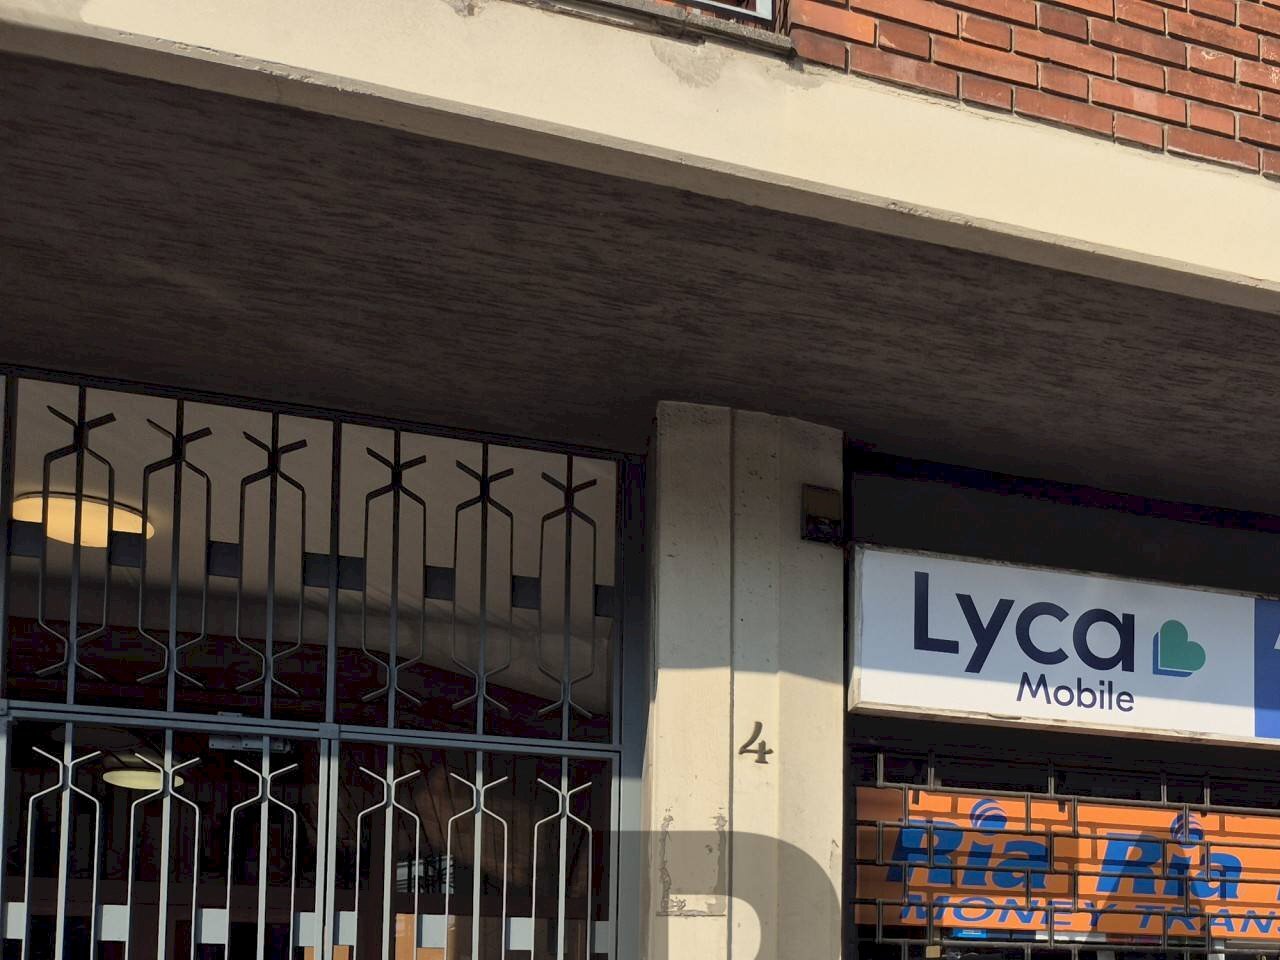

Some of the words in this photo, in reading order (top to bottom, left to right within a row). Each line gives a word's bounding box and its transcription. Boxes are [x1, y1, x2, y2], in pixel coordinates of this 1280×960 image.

[914, 571, 1135, 673] Lyca
[1016, 672, 1134, 712] Mobile
[738, 721, 774, 764] 4
[886, 800, 1047, 889] Ria
[1099, 814, 1242, 901] Ria
[900, 891, 1115, 929] MONEY
